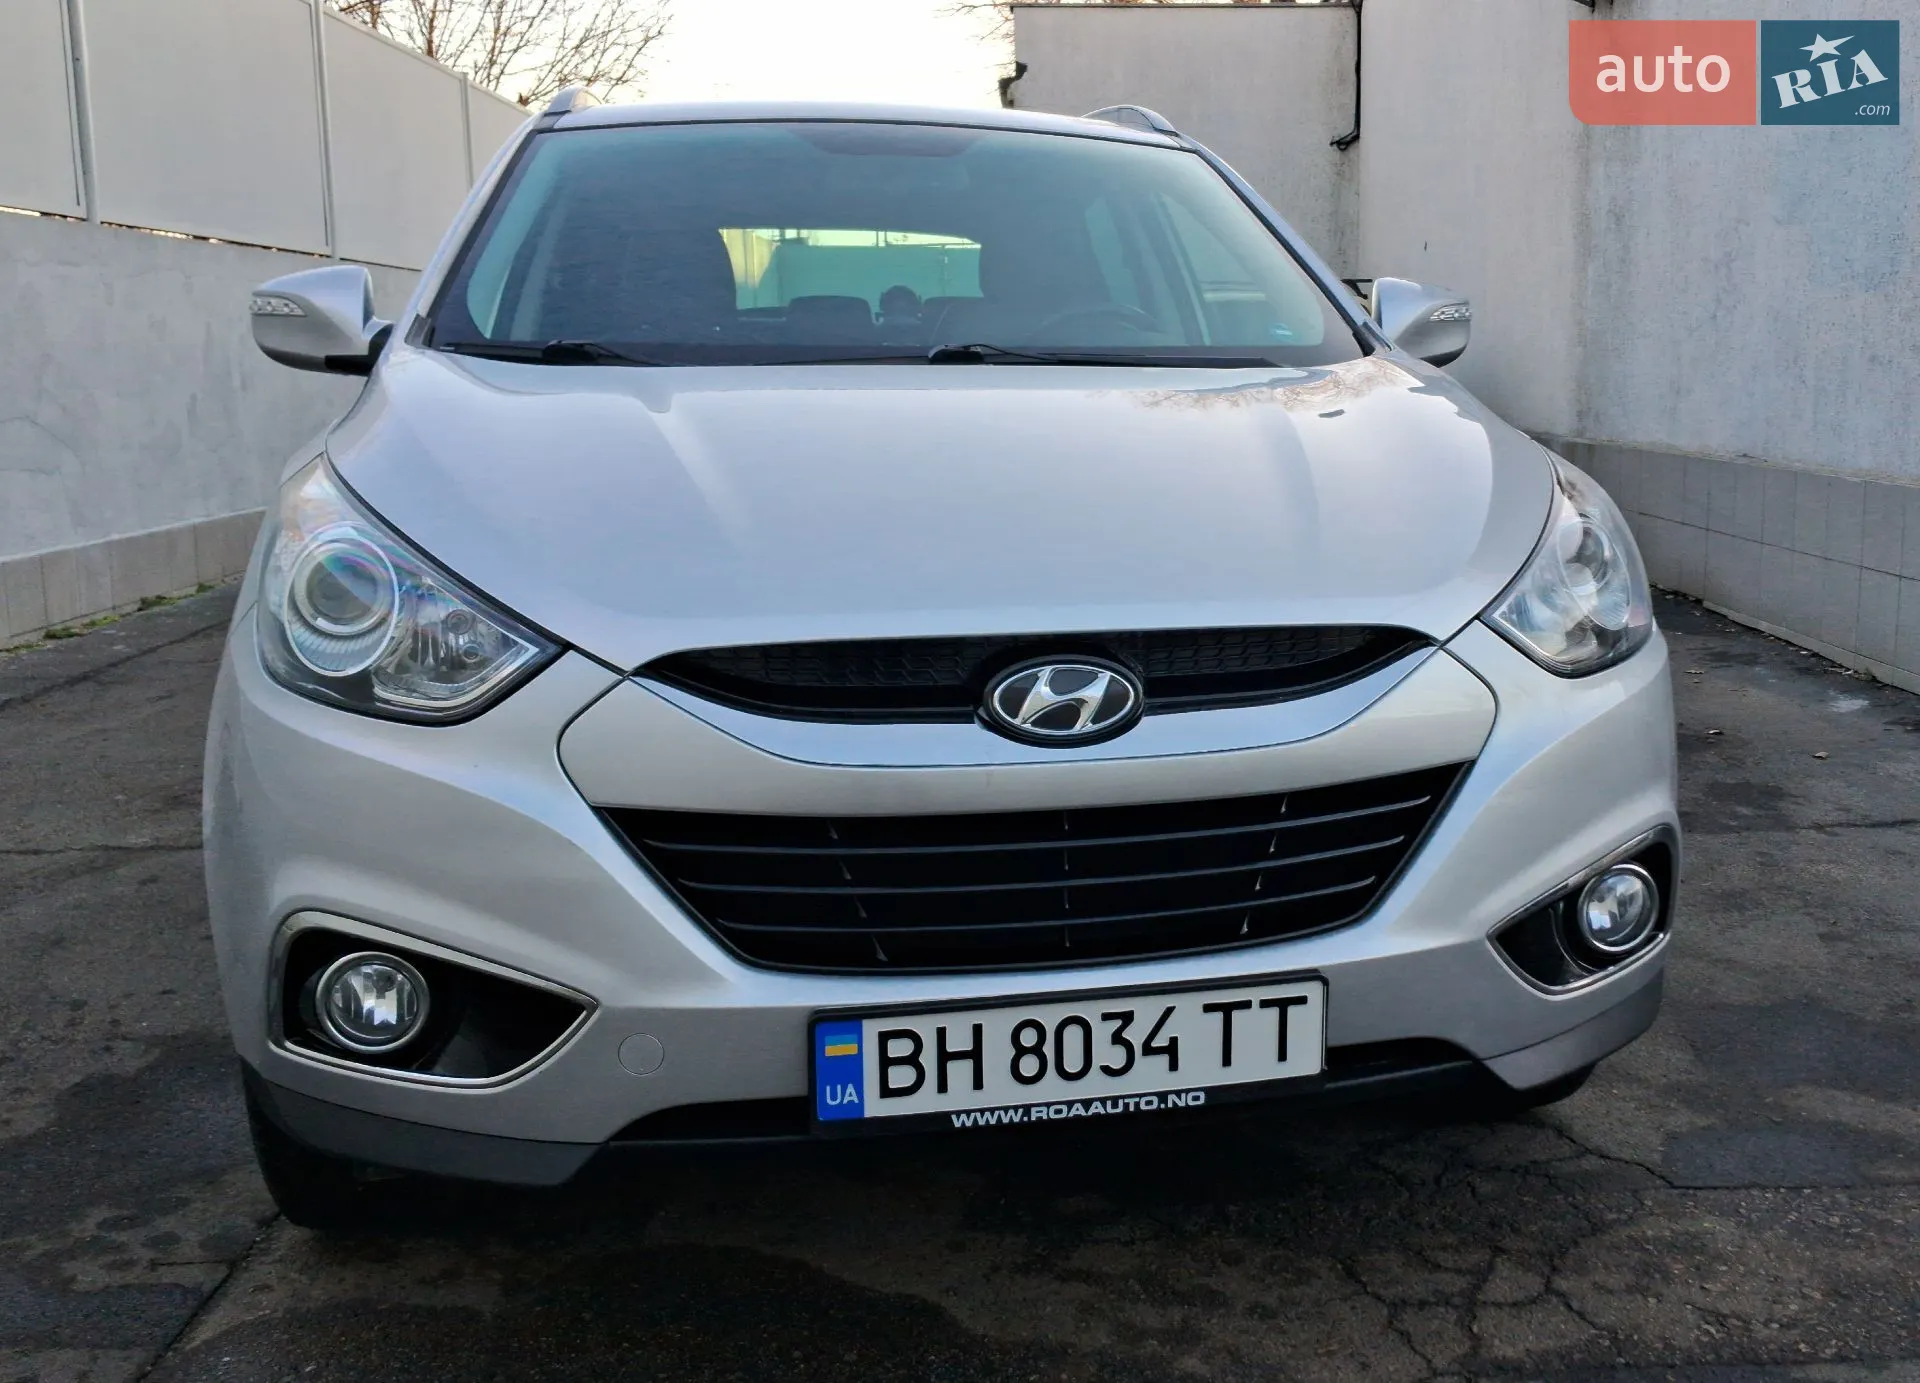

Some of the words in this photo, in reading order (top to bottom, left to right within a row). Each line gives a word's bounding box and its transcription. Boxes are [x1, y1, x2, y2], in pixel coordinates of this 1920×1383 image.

[878, 1022, 984, 1099] BH
[1010, 1005, 1179, 1085] 8034
[1202, 995, 1308, 1067] TT
[825, 1084, 859, 1105] UA
[951, 1091, 1206, 1128] WWW.ROAAUTO.NO
